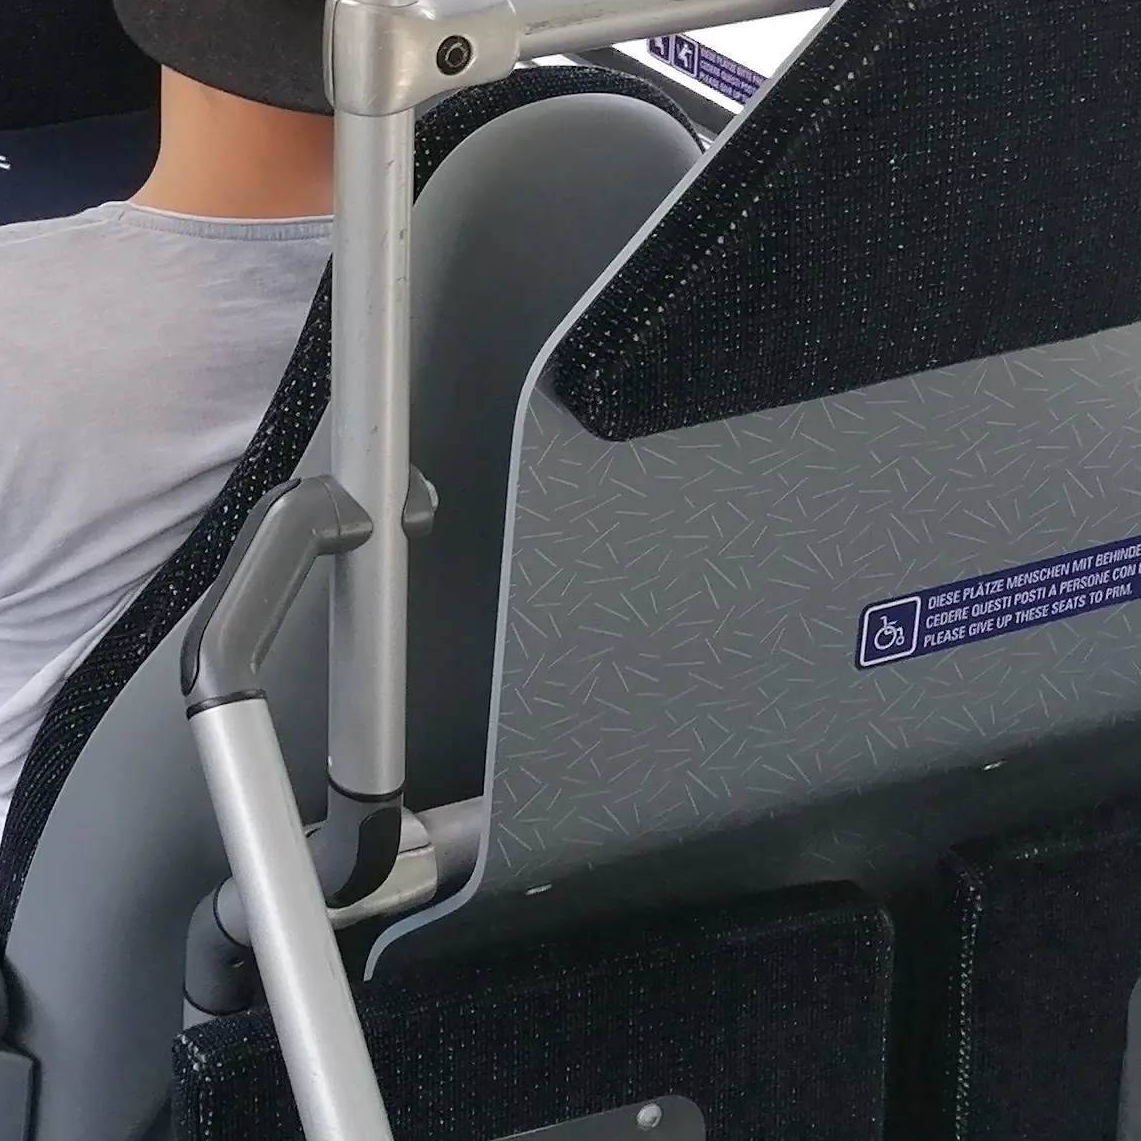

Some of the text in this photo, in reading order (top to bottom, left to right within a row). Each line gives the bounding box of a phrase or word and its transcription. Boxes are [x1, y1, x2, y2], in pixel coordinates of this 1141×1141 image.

[926, 606, 970, 629] CEDERE
[971, 595, 1012, 617] QUESTI
[1013, 587, 1046, 606] POSTI
[1047, 584, 1057, 598] A
[1059, 570, 1110, 594] PERSONE
[1112, 564, 1136, 581] CON
[928, 590, 961, 610] DIESE
[1006, 562, 1070, 590] MENSCHEN
[1072, 556, 1094, 573] MIT
[923, 625, 966, 648] PLEASE
[968, 618, 994, 637] GIVE
[996, 614, 1013, 629] UP
[1015, 604, 1050, 624] THESE
[1051, 594, 1086, 615] SEATS
[1088, 590, 1103, 605] TO
